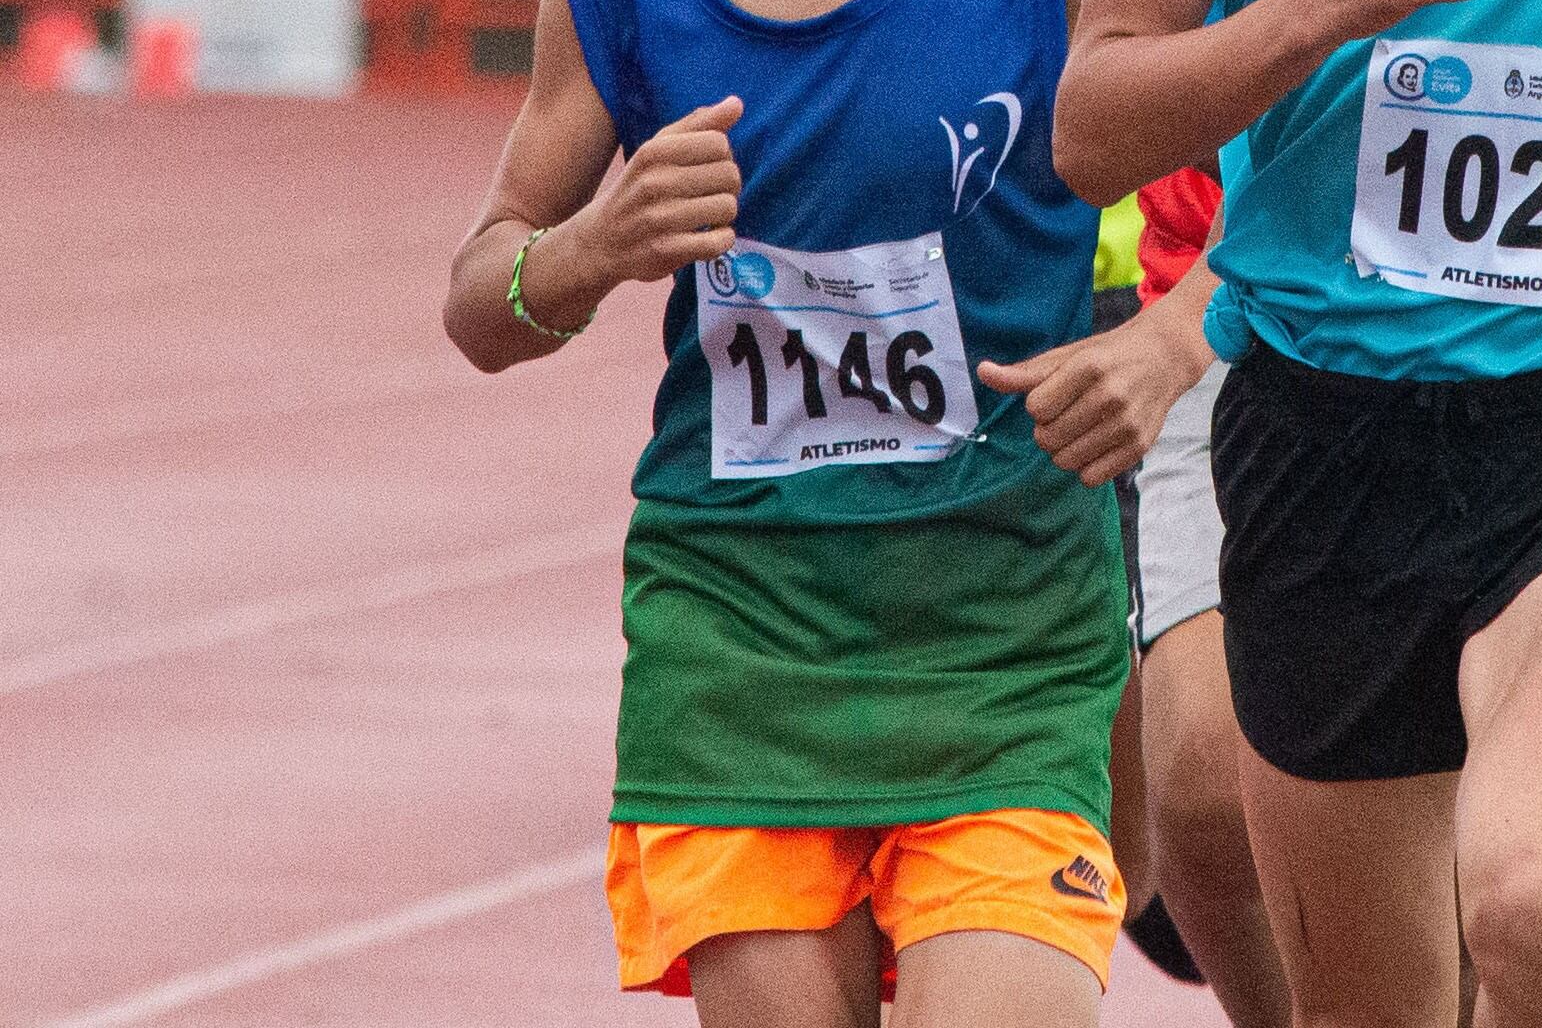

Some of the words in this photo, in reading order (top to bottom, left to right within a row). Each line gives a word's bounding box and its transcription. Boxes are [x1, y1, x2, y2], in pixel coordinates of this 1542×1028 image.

[726, 323, 946, 427] 1146
[800, 437, 901, 461] ATLETISMO
[1067, 854, 1107, 893] NIKE
